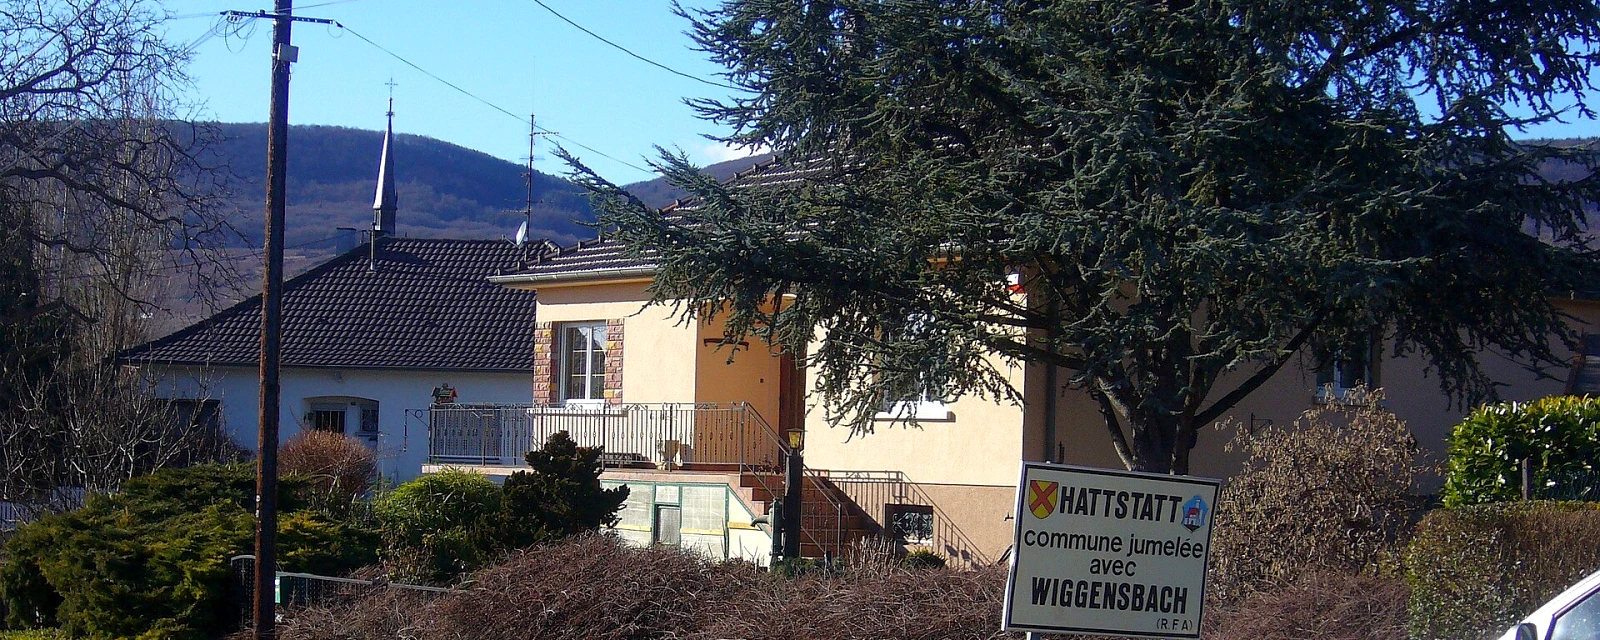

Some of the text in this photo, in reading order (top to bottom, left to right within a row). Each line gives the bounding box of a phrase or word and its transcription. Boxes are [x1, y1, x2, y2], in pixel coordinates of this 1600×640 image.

[1059, 486, 1182, 523] HATTSTATT
[1024, 529, 1203, 558] commune jumelée
[1089, 558, 1137, 577] avec
[1031, 577, 1188, 614] WIGGENSBACH
